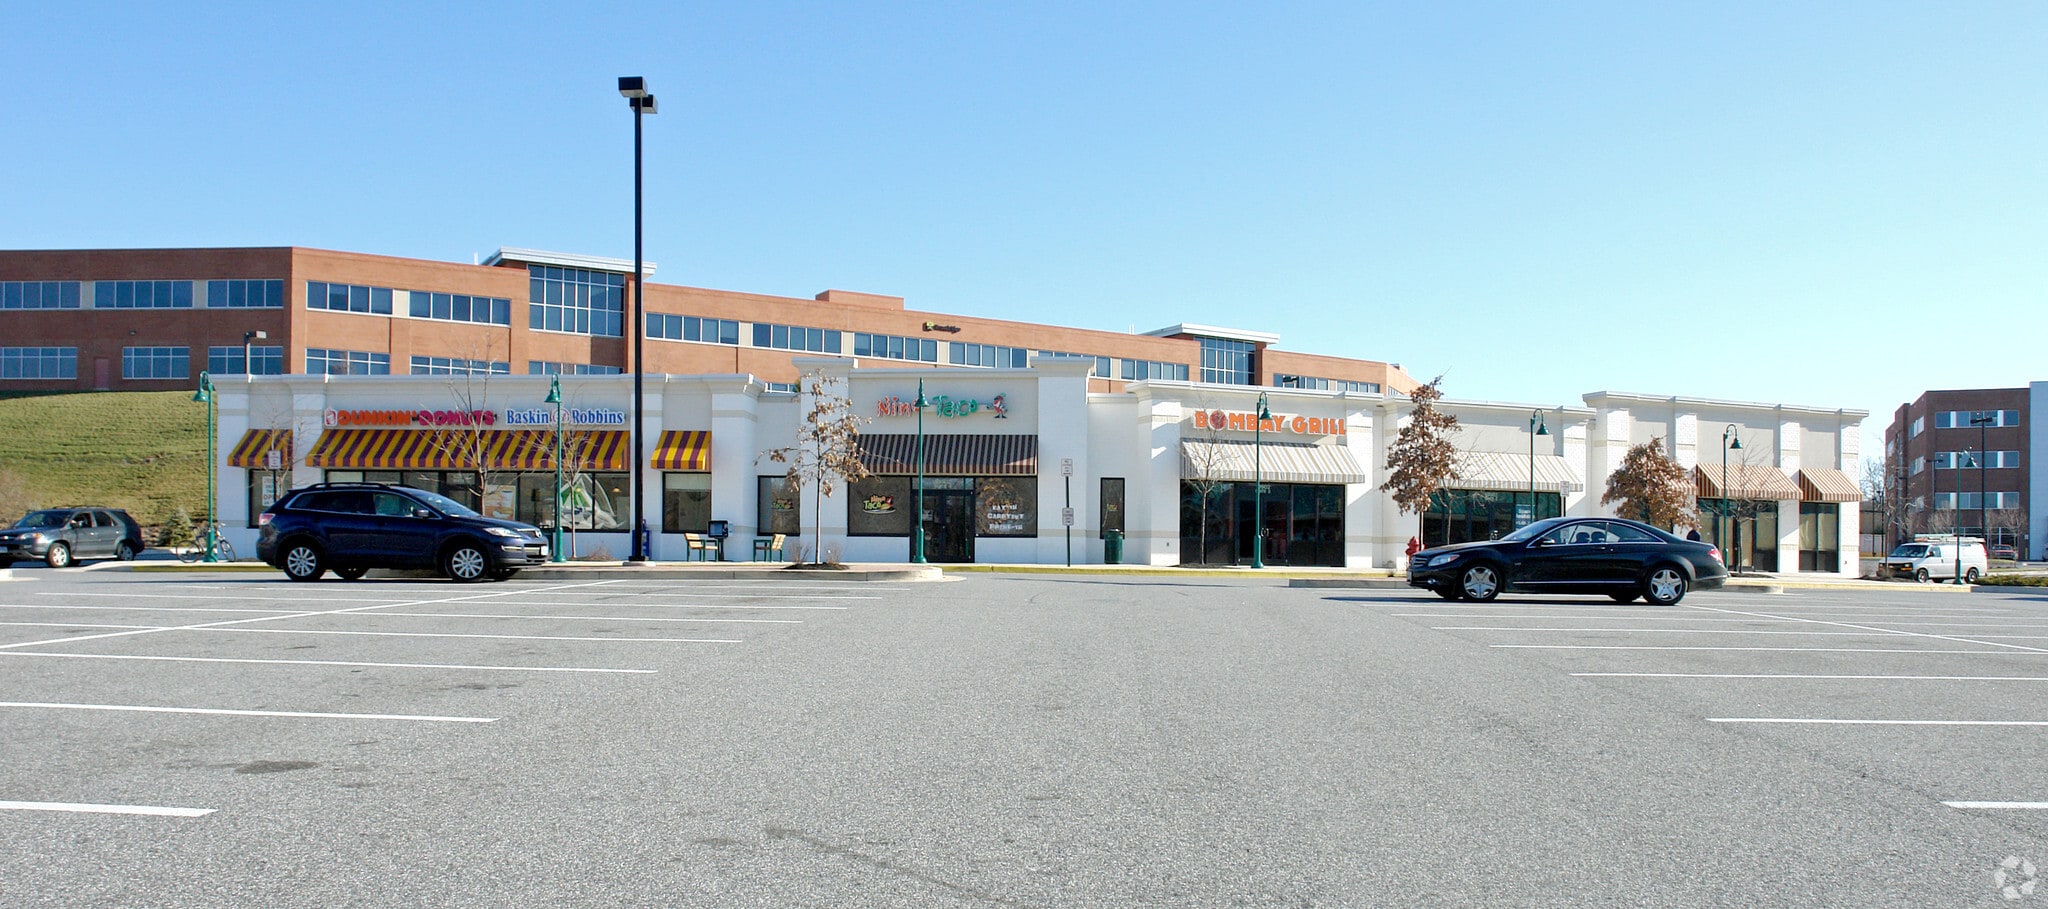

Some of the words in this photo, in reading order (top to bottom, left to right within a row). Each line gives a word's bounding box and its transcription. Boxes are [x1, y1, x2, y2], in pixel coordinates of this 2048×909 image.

[932, 394, 979, 418] Taco
[337, 409, 417, 426] DUNKIN'
[419, 410, 495, 426] DONUTS
[506, 409, 549, 424] Baskin
[572, 409, 624, 424] Robbins
[1194, 409, 1286, 431] BOMBAY
[1291, 416, 1346, 435] GRILL
